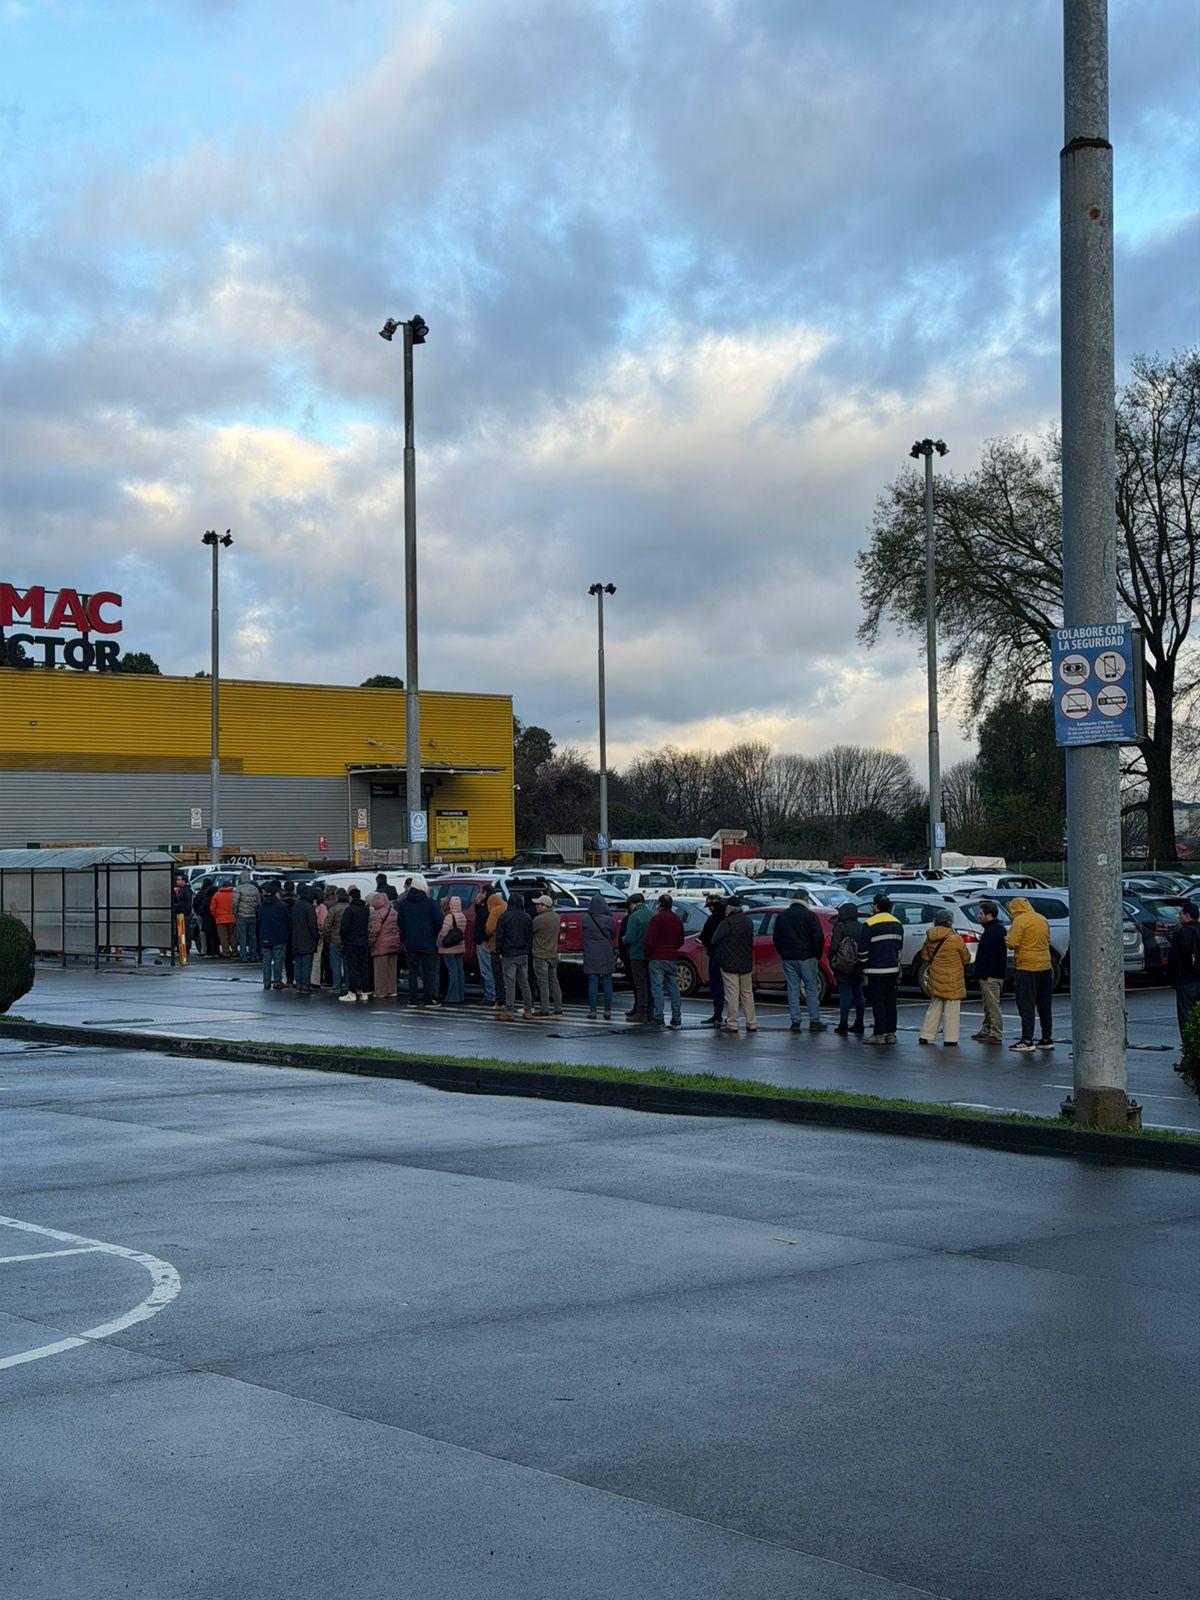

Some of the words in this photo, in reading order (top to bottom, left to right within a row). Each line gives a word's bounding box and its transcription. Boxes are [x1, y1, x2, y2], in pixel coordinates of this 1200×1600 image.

[0, 583, 122, 634] MAC
[1057, 626, 1104, 640] COLABORE
[1105, 624, 1125, 636] CON
[1058, 640, 1070, 651] LA
[1071, 635, 1124, 650] SEGURIDAD
[0, 633, 121, 672] CTOR
